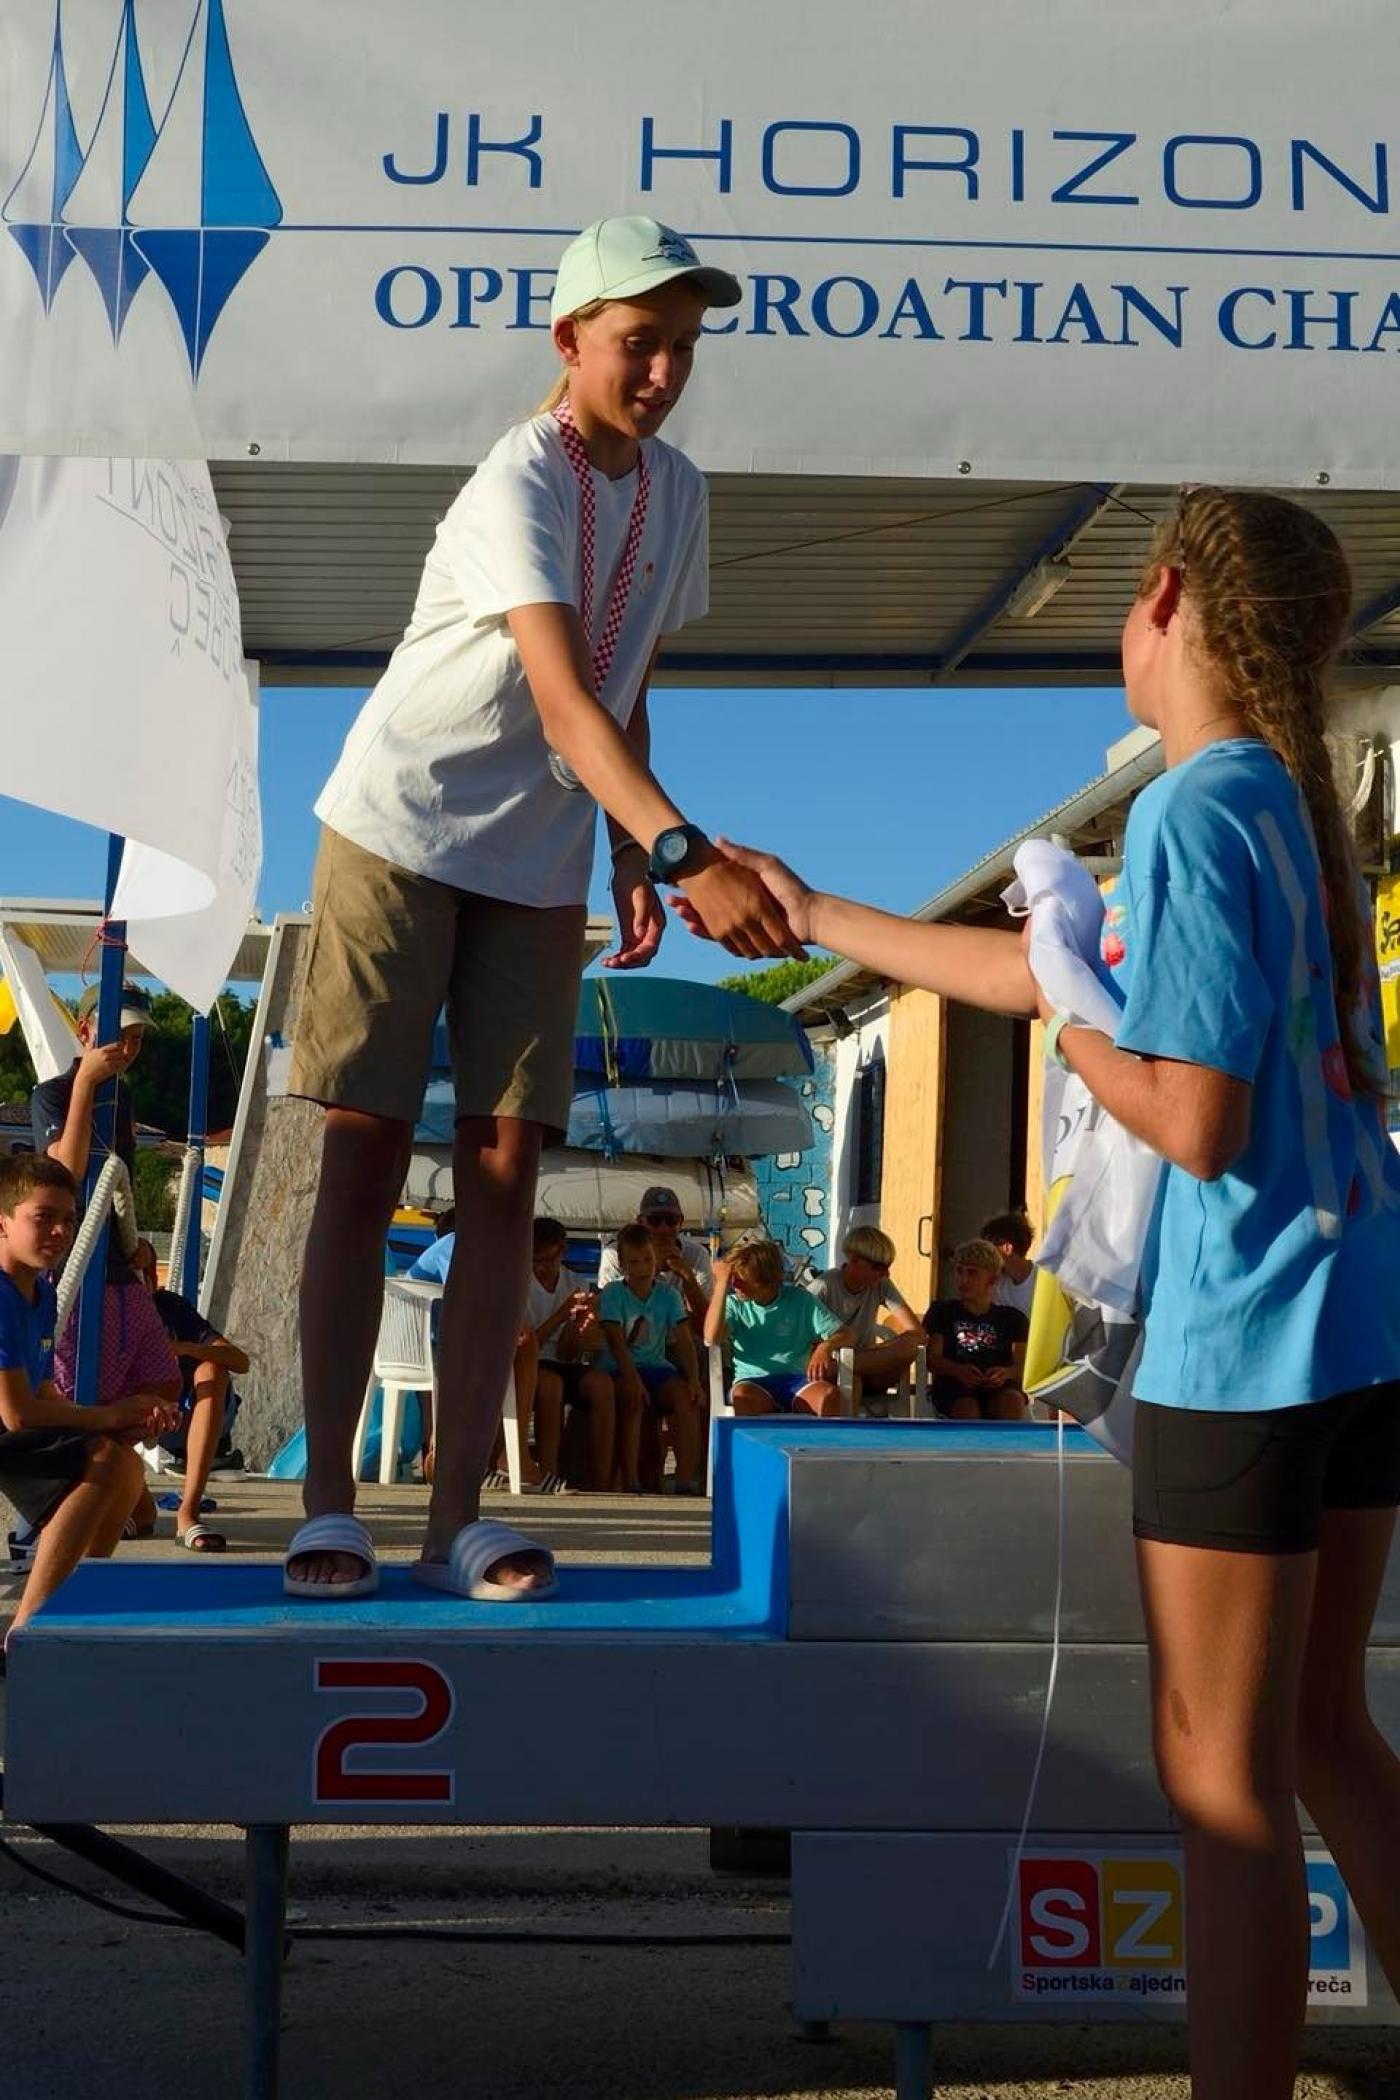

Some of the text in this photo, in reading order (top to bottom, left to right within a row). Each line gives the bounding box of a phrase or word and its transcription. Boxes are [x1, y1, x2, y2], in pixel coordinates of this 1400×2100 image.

[382, 112, 1389, 214] JK HORIZON
[701, 274, 1189, 348] ROATIAN
[312, 1657, 456, 1806] 2
[1022, 1973, 1114, 1993] Sportska
